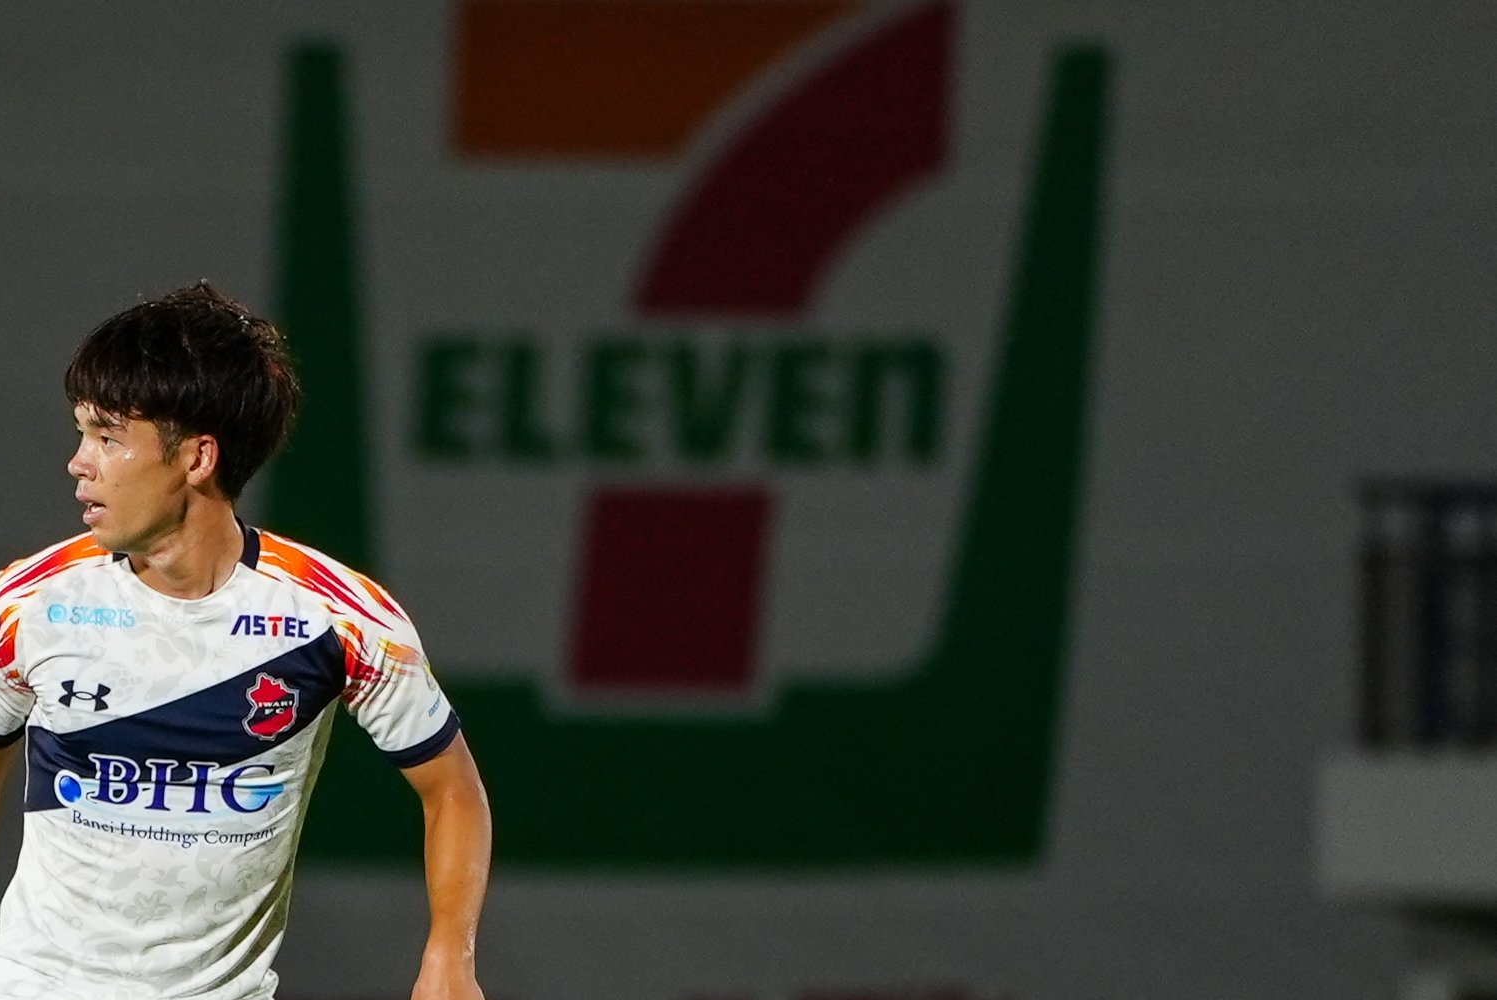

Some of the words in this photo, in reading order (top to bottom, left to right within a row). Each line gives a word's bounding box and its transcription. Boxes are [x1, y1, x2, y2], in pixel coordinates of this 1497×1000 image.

[230, 615, 310, 638] ASTEC
[258, 700, 293, 708] IWAKI
[72, 809, 116, 834] Banei
[120, 821, 199, 848] Holdings
[204, 828, 277, 848] Company
